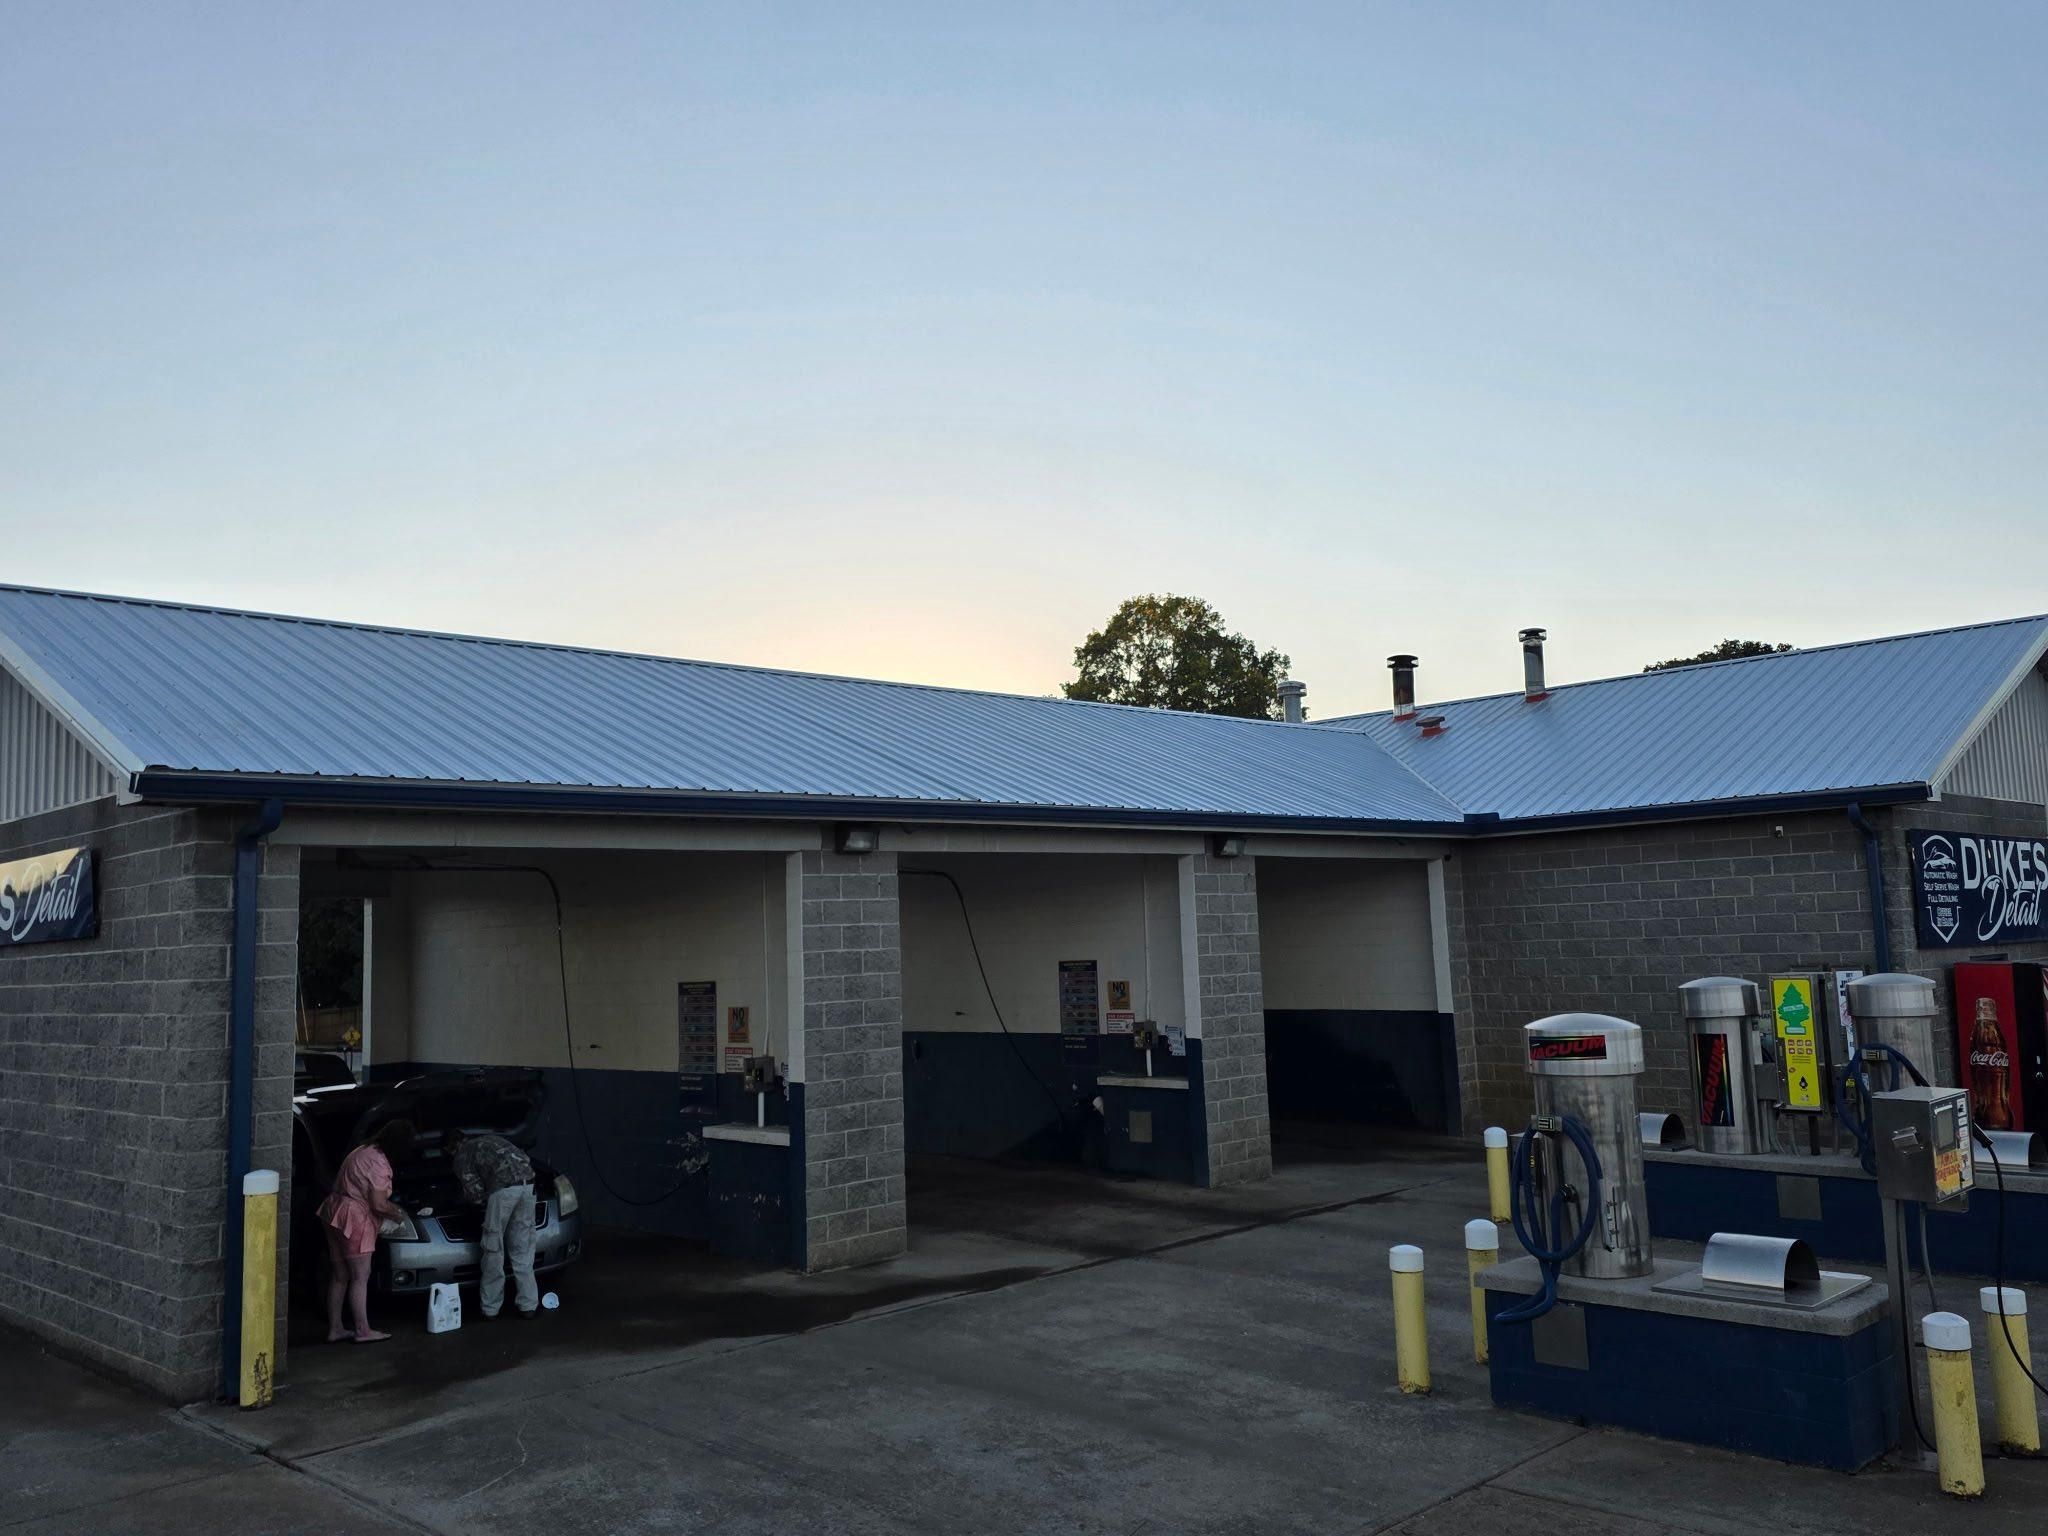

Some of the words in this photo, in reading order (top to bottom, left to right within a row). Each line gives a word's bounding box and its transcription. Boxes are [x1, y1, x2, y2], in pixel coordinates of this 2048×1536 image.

[11, 857, 84, 942] Detail
[1977, 874, 2042, 942] Detail
[1112, 981, 1126, 993] NO
[1700, 1038, 1725, 1125] VACUUM
